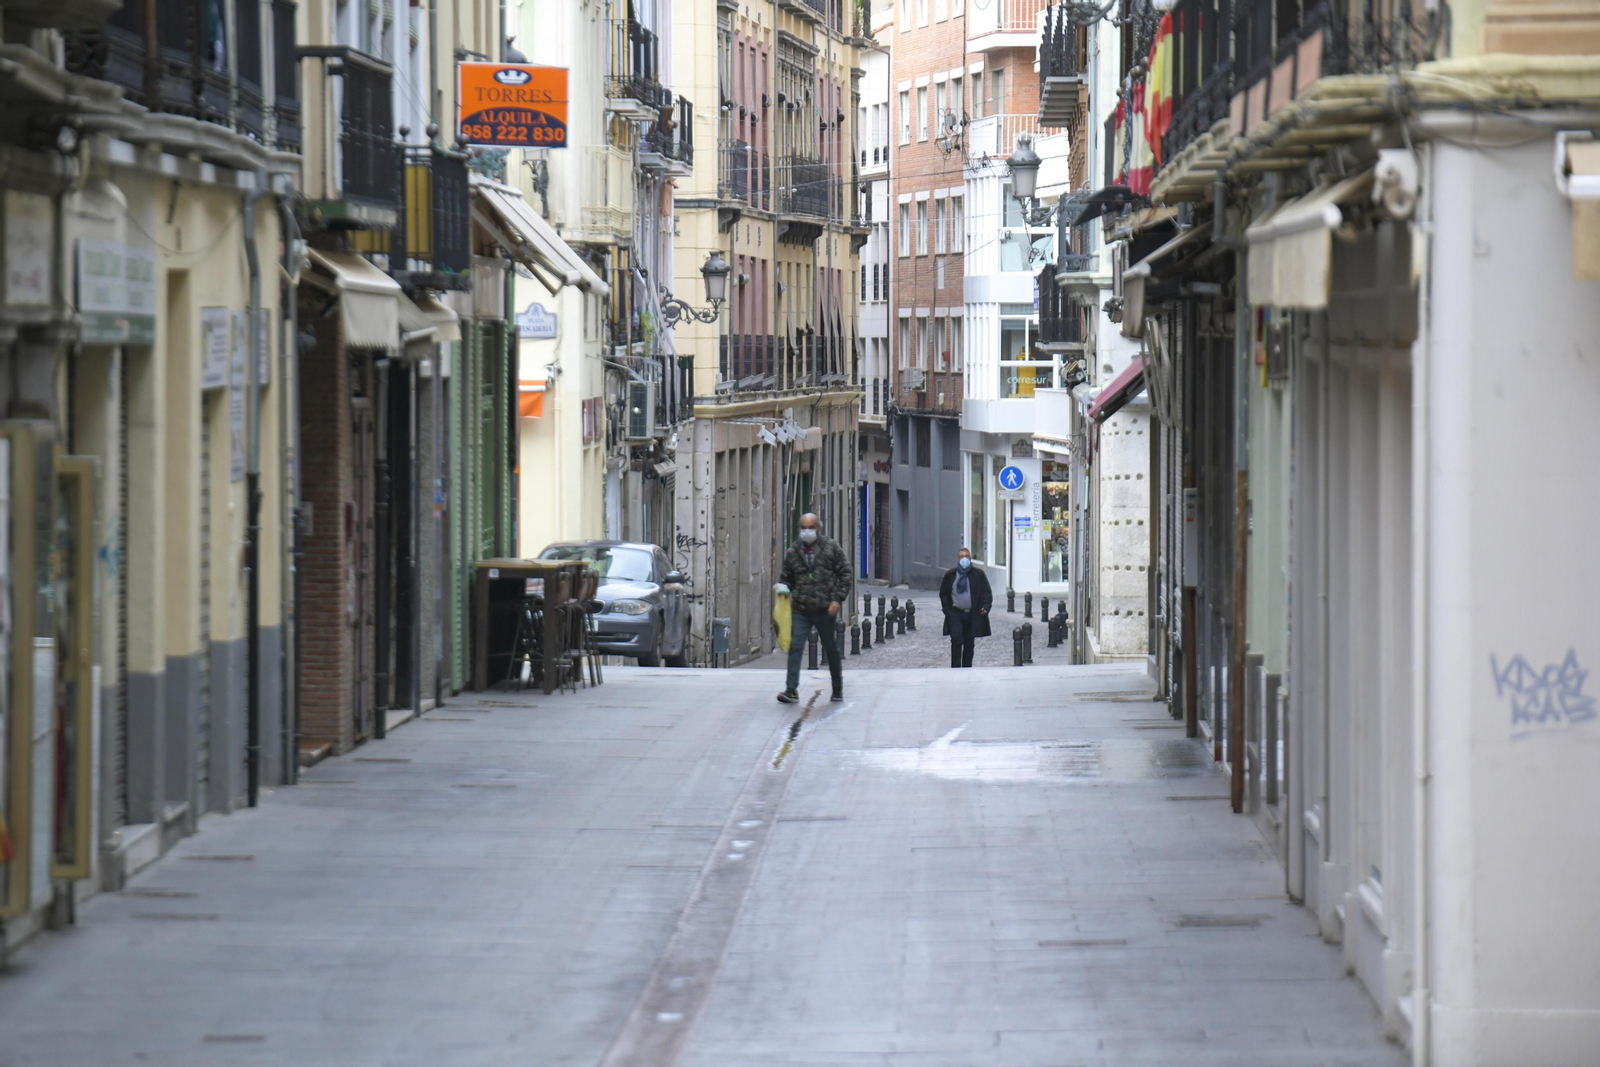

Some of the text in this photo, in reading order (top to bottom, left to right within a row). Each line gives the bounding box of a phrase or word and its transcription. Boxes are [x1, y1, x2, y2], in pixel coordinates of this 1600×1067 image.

[475, 87, 553, 103] TORRES
[479, 110, 548, 125] ALQUILA
[462, 124, 565, 142] 958 222 830
[1007, 376, 1046, 384] corresur
